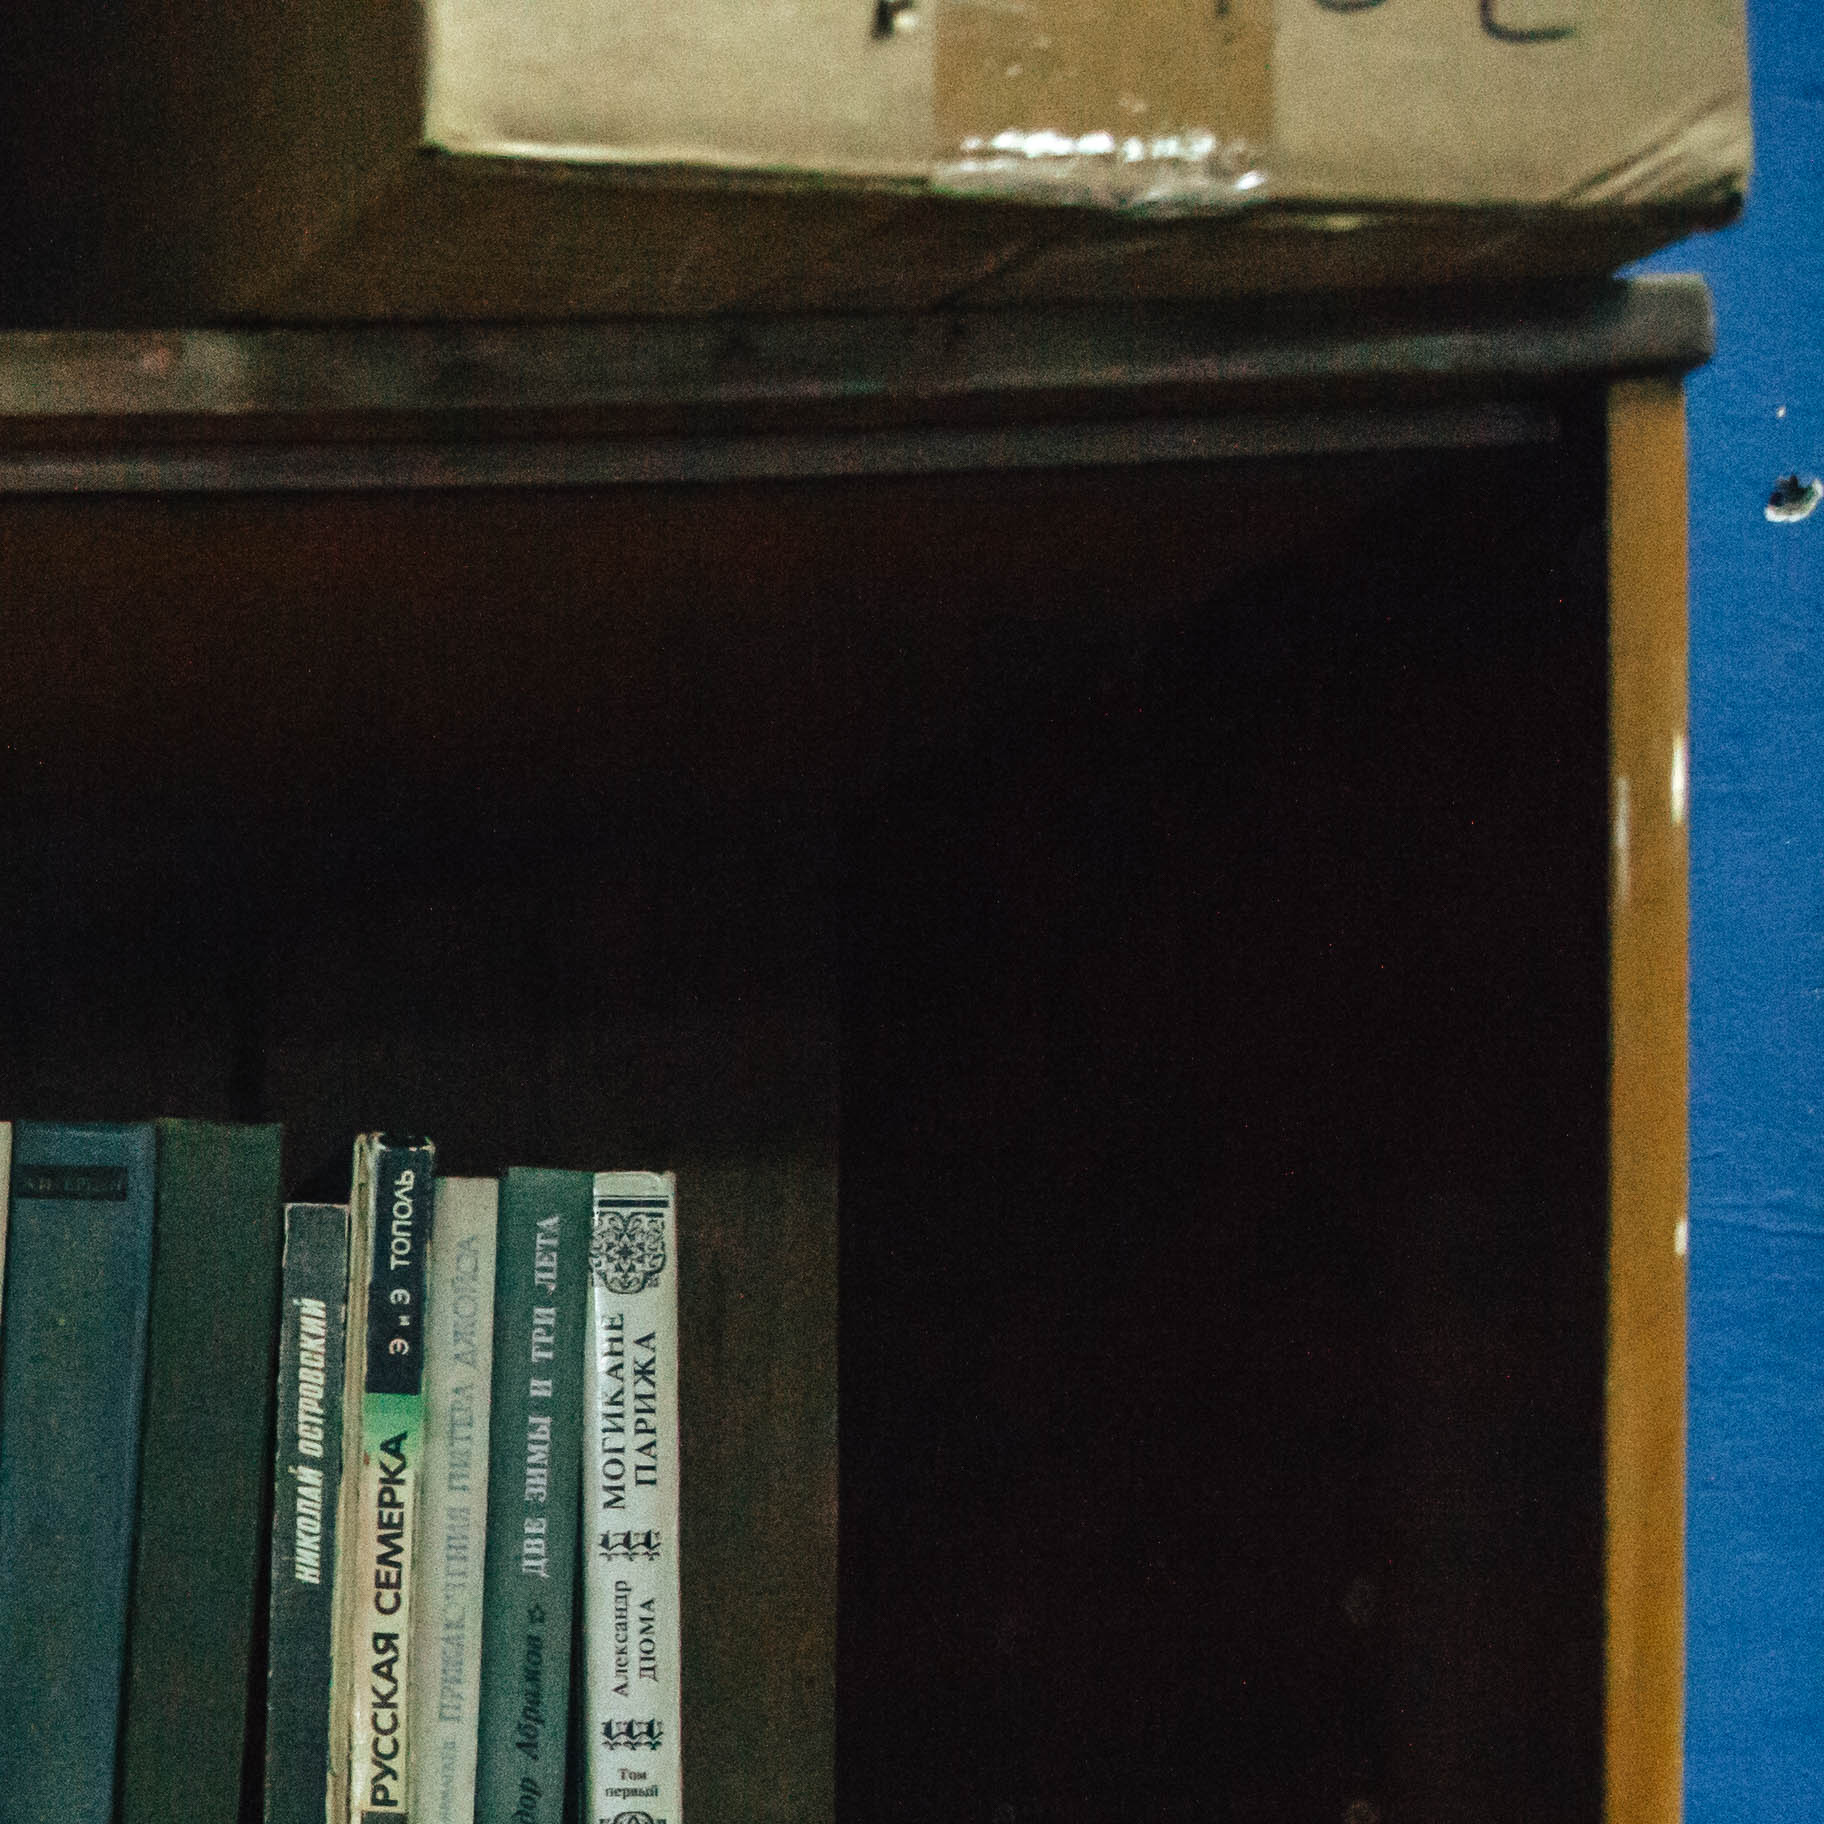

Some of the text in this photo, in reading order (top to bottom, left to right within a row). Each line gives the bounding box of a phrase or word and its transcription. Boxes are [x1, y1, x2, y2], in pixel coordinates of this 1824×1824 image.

[390, 1168, 417, 1269] ТОПОЛЬ
[389, 1287, 411, 1305] Э
[389, 1336, 410, 1355] Э
[288, 1296, 327, 1584] НИКОЛАЙ ОСТРОВСКИЙ
[521, 1212, 560, 1578] ДВЕ ЗИМЫ И ТРИ ЛЕТА
[598, 1311, 627, 1511] МОГИКАНЕ
[631, 1329, 658, 1485] ПАРИЖА
[370, 1429, 409, 1806] РУССКАЯ СЕМЕРКА
[609, 1578, 634, 1697] Александр
[637, 1597, 658, 1681] ДЮМА
[513, 1633, 544, 1758] Абрамов
[605, 1784, 659, 1800] первый
[618, 1768, 647, 1781] Том
